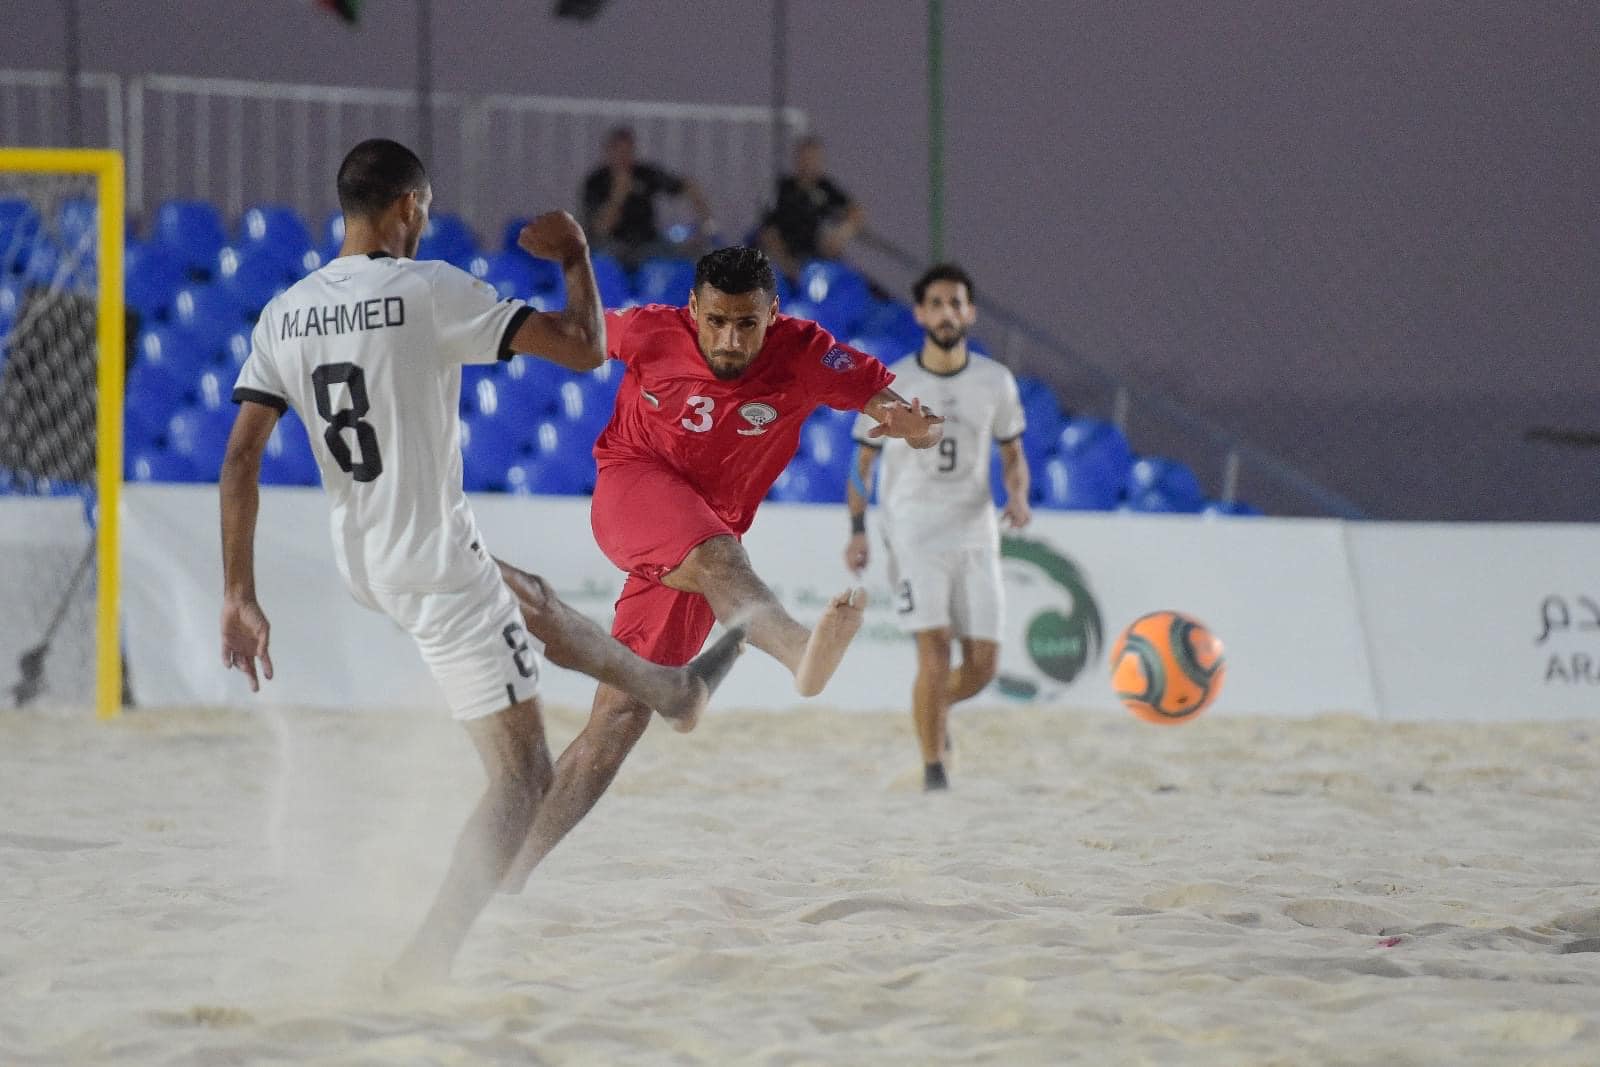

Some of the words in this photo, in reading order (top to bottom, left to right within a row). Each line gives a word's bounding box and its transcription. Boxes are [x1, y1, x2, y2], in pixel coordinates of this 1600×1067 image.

[281, 296, 405, 341] M.AHMED
[311, 361, 383, 483] 8
[681, 395, 714, 433] 3
[938, 437, 957, 473] 9
[1544, 653, 1600, 686] AR
